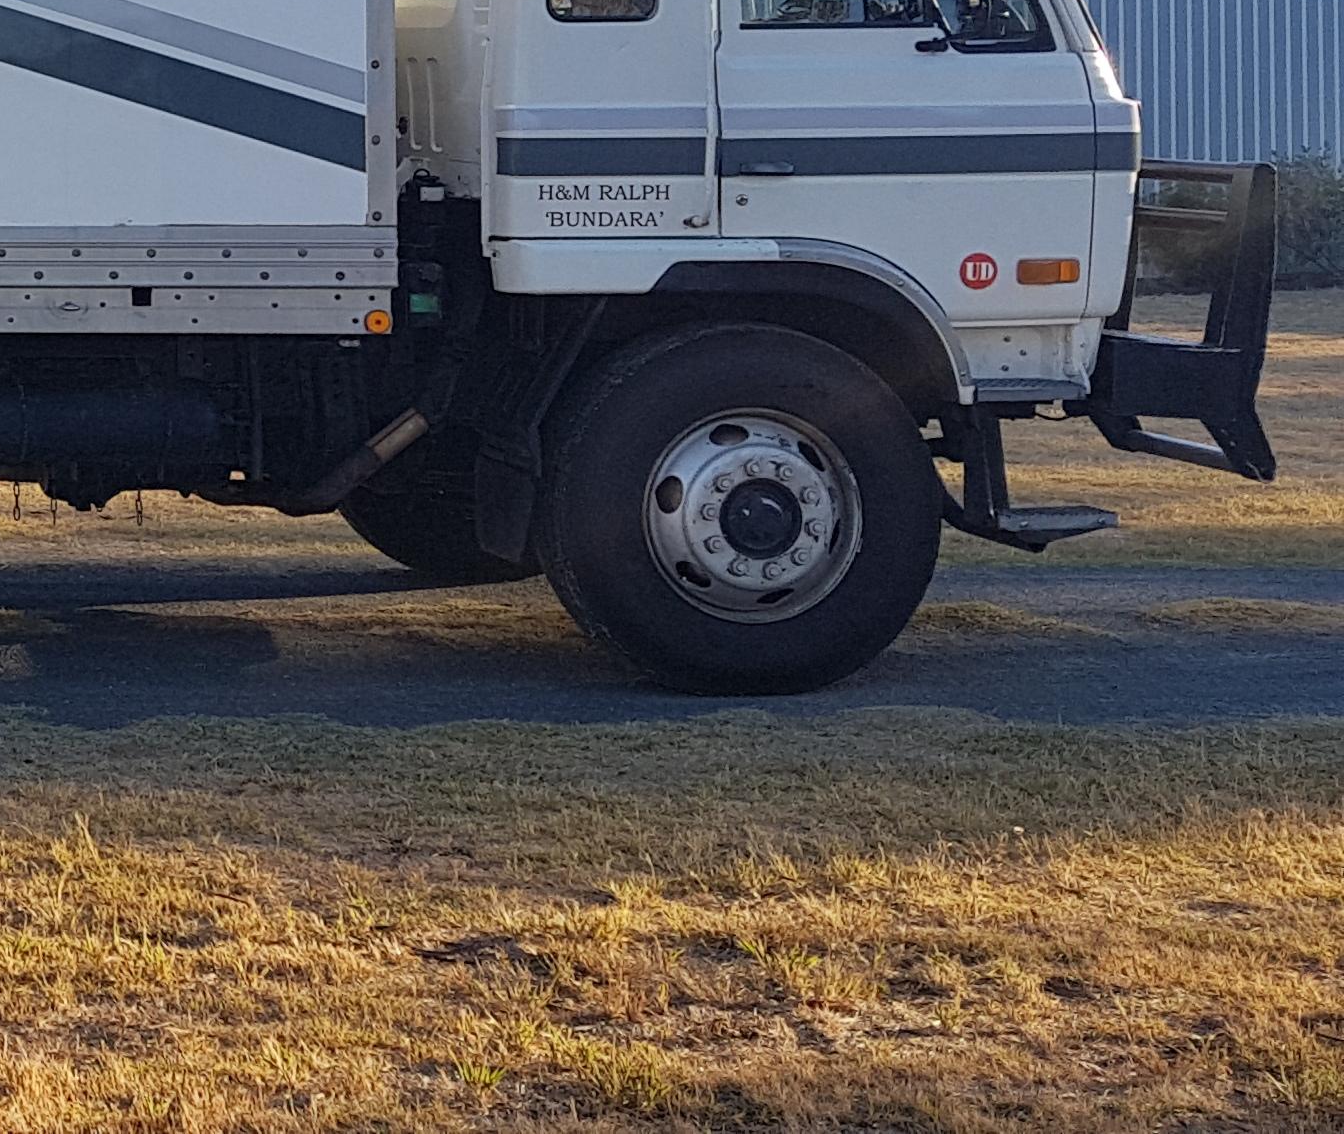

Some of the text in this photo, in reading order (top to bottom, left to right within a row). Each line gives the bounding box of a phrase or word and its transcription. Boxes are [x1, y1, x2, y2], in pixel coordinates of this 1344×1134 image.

[538, 184, 671, 201] H&M RALPH
[964, 261, 994, 281] UD
